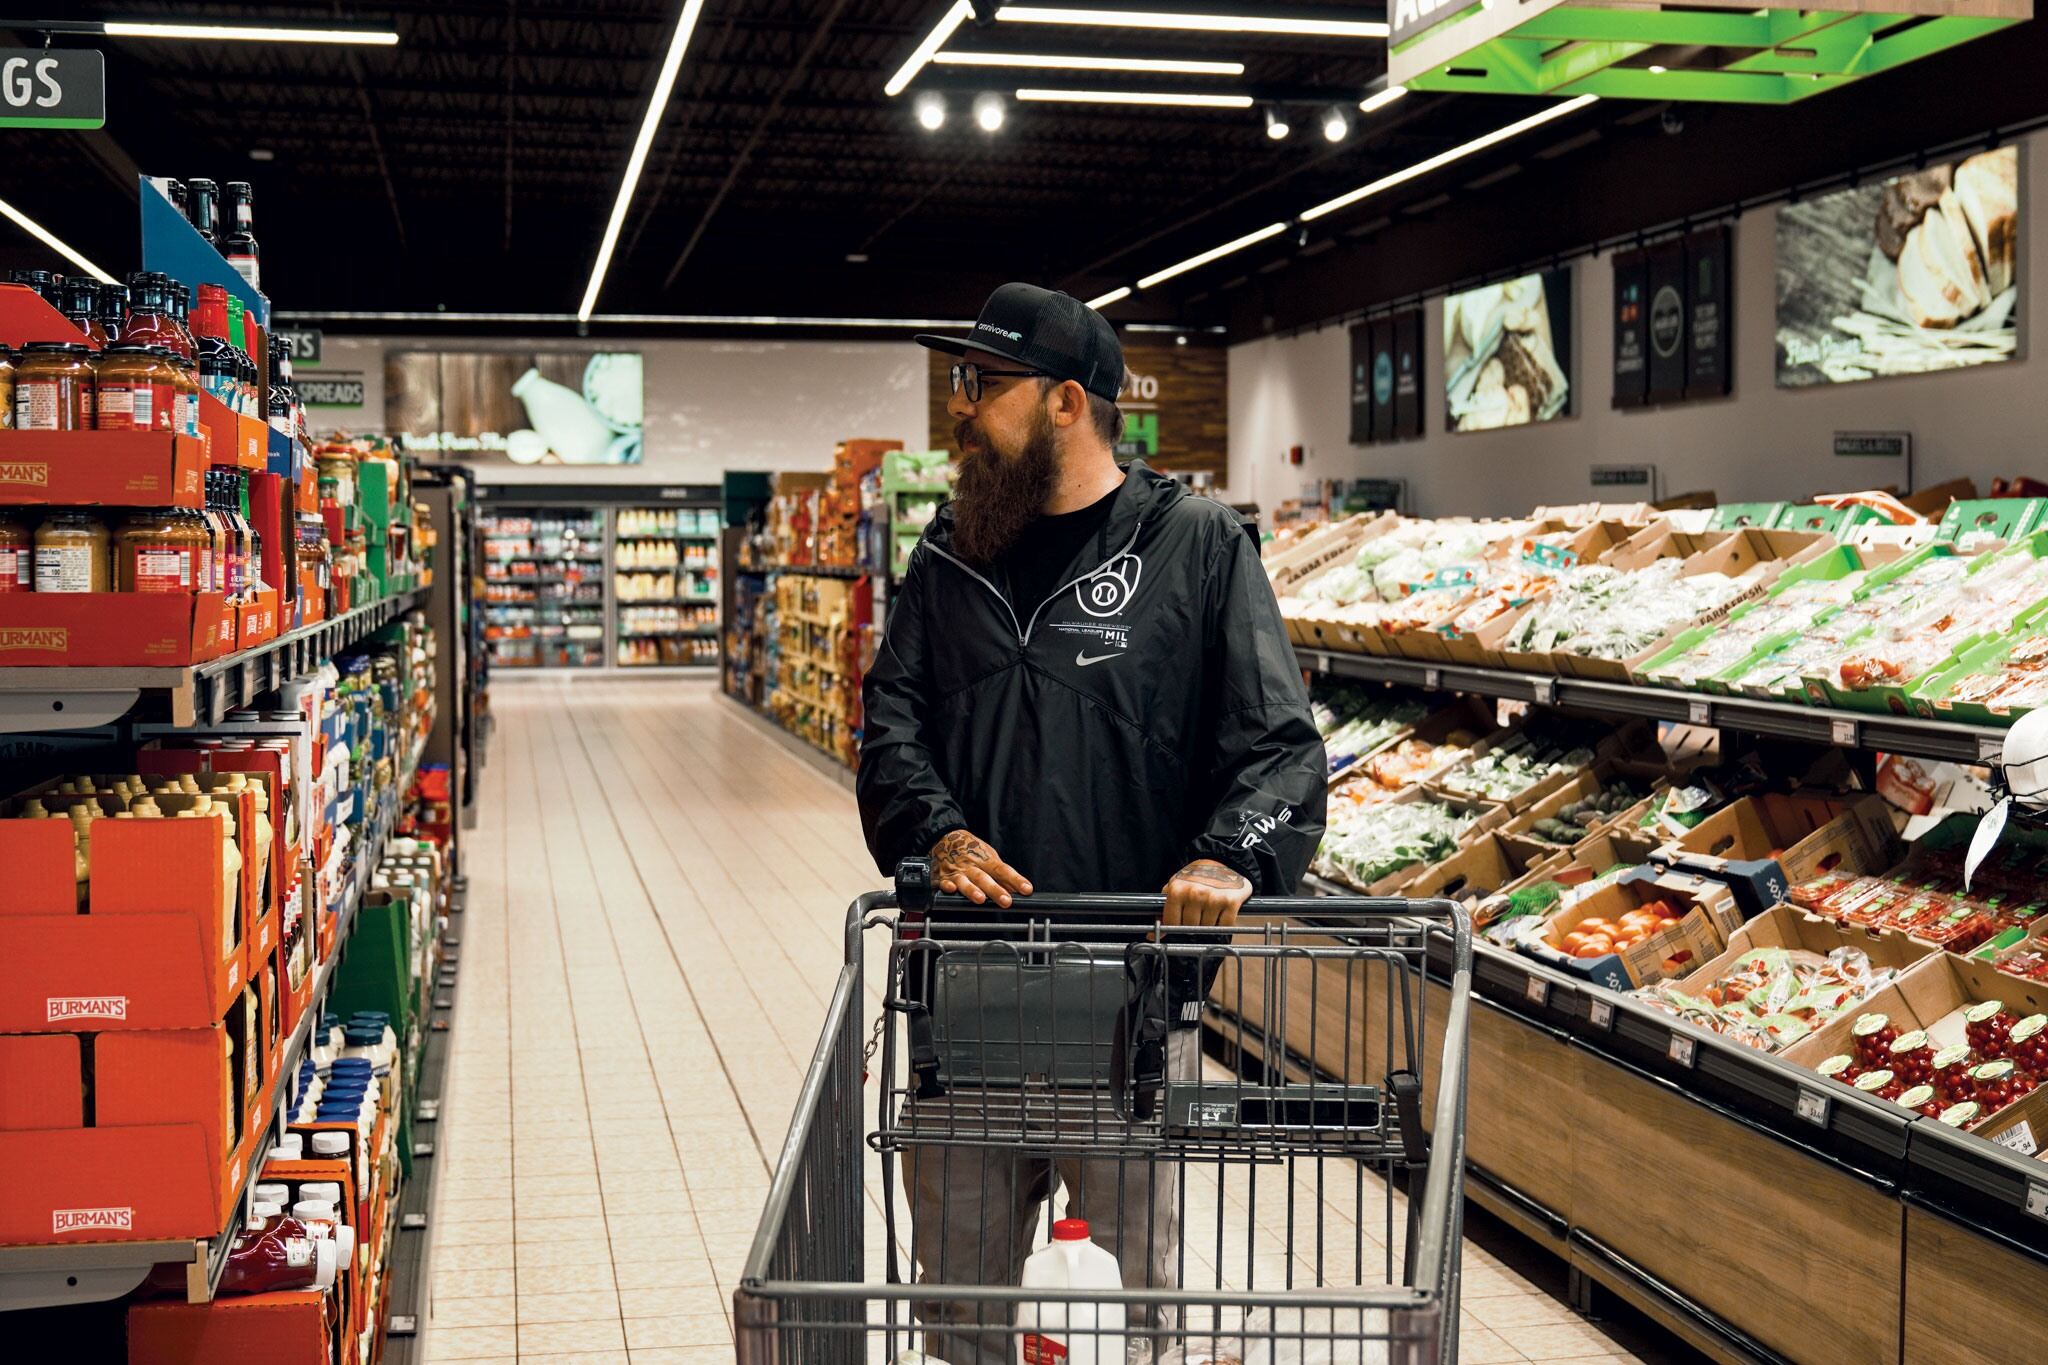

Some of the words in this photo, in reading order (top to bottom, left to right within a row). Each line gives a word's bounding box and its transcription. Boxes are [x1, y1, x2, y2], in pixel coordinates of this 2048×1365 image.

[2, 57, 62, 107] GS
[978, 323, 1009, 337] omnivore
[298, 382, 361, 403] SPREADS
[1105, 630, 1128, 642] MIL
[50, 1000, 124, 1017] BURMAN'S
[55, 1211, 130, 1229] BURMAN'S
